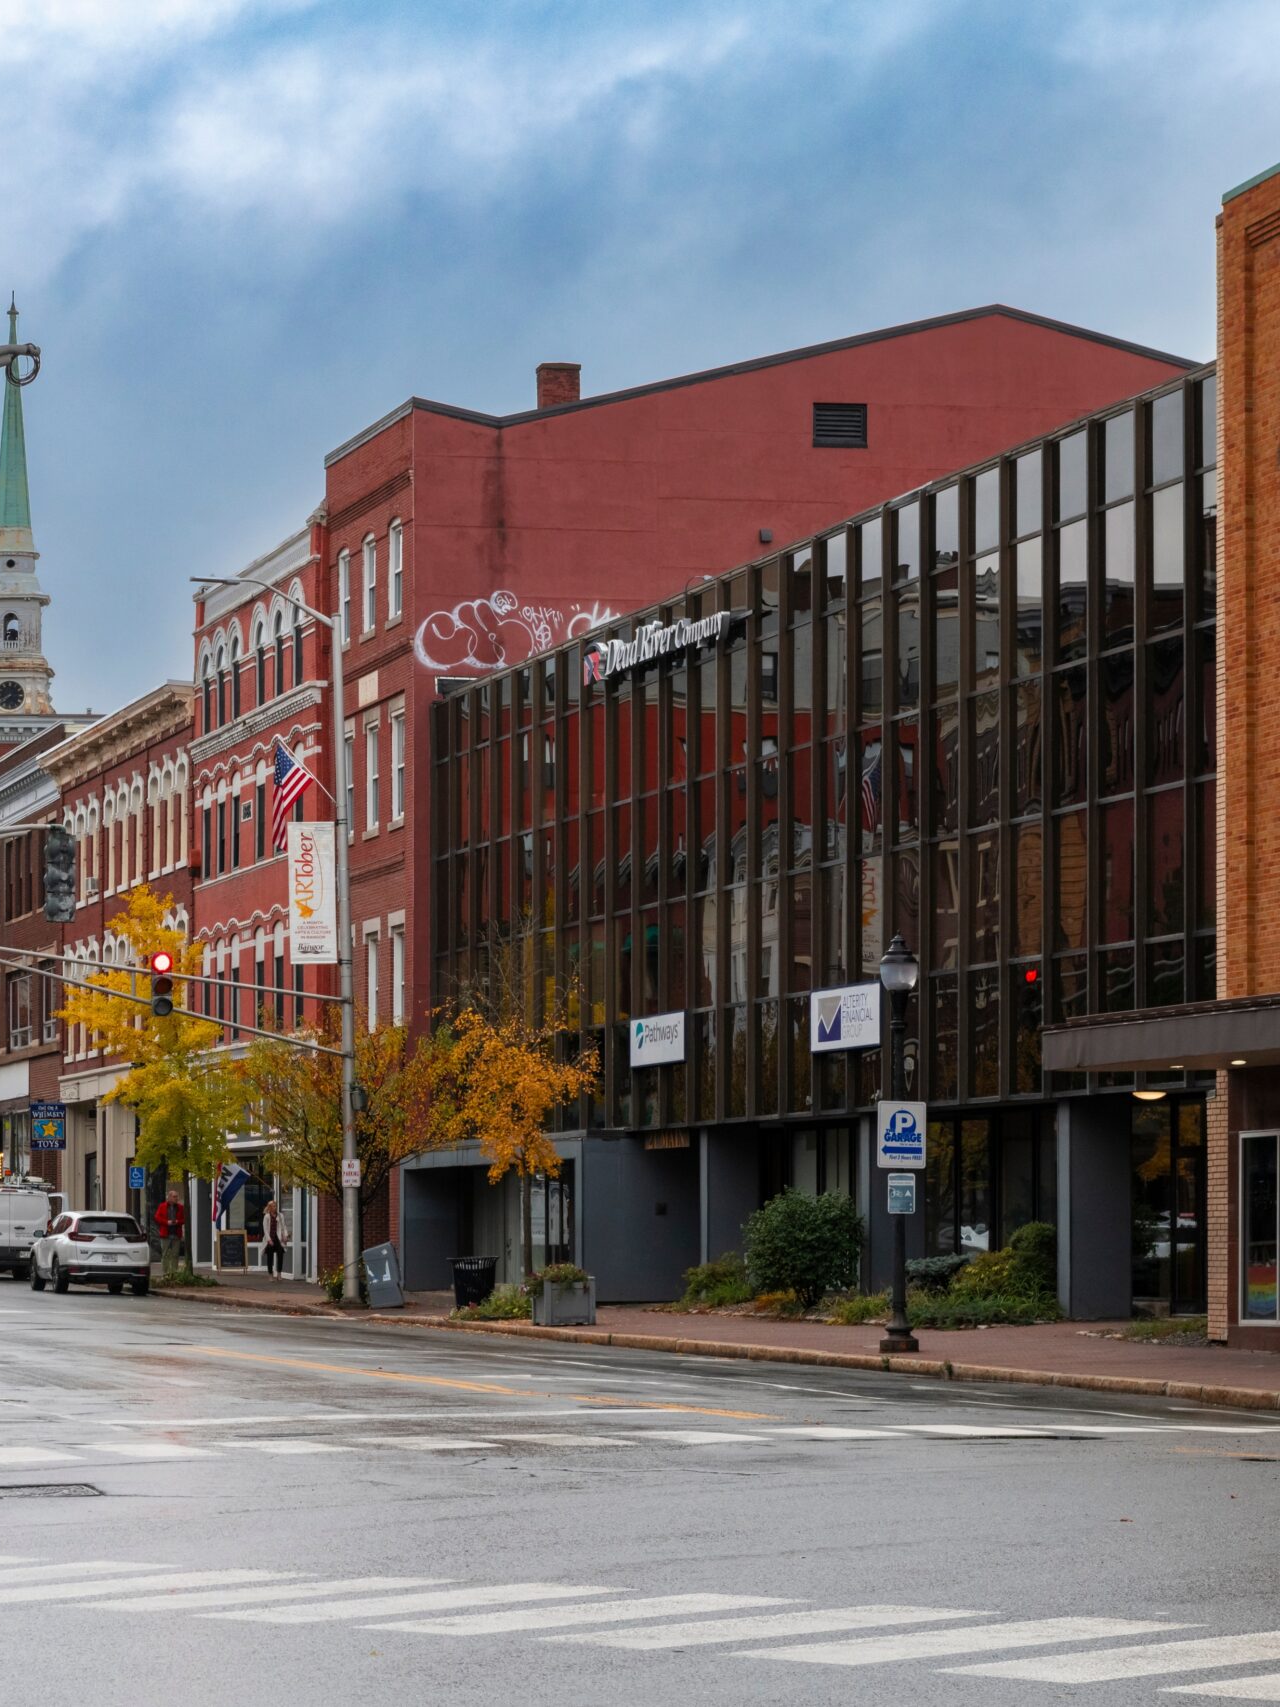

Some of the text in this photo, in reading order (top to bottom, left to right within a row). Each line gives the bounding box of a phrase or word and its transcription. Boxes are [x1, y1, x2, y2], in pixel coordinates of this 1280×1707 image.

[605, 612, 725, 676] Dead River Company
[294, 831, 314, 911] ARTober
[297, 943, 325, 952] Bangor
[842, 992, 868, 1008] ALTERITY
[842, 1008, 873, 1022] FINANCIAL
[644, 1022, 679, 1044] Pathways
[842, 1023, 863, 1039] GROUP
[895, 1113, 914, 1134] P
[37, 1140, 60, 1148] TOYS
[884, 1133, 922, 1143] GARAGE
